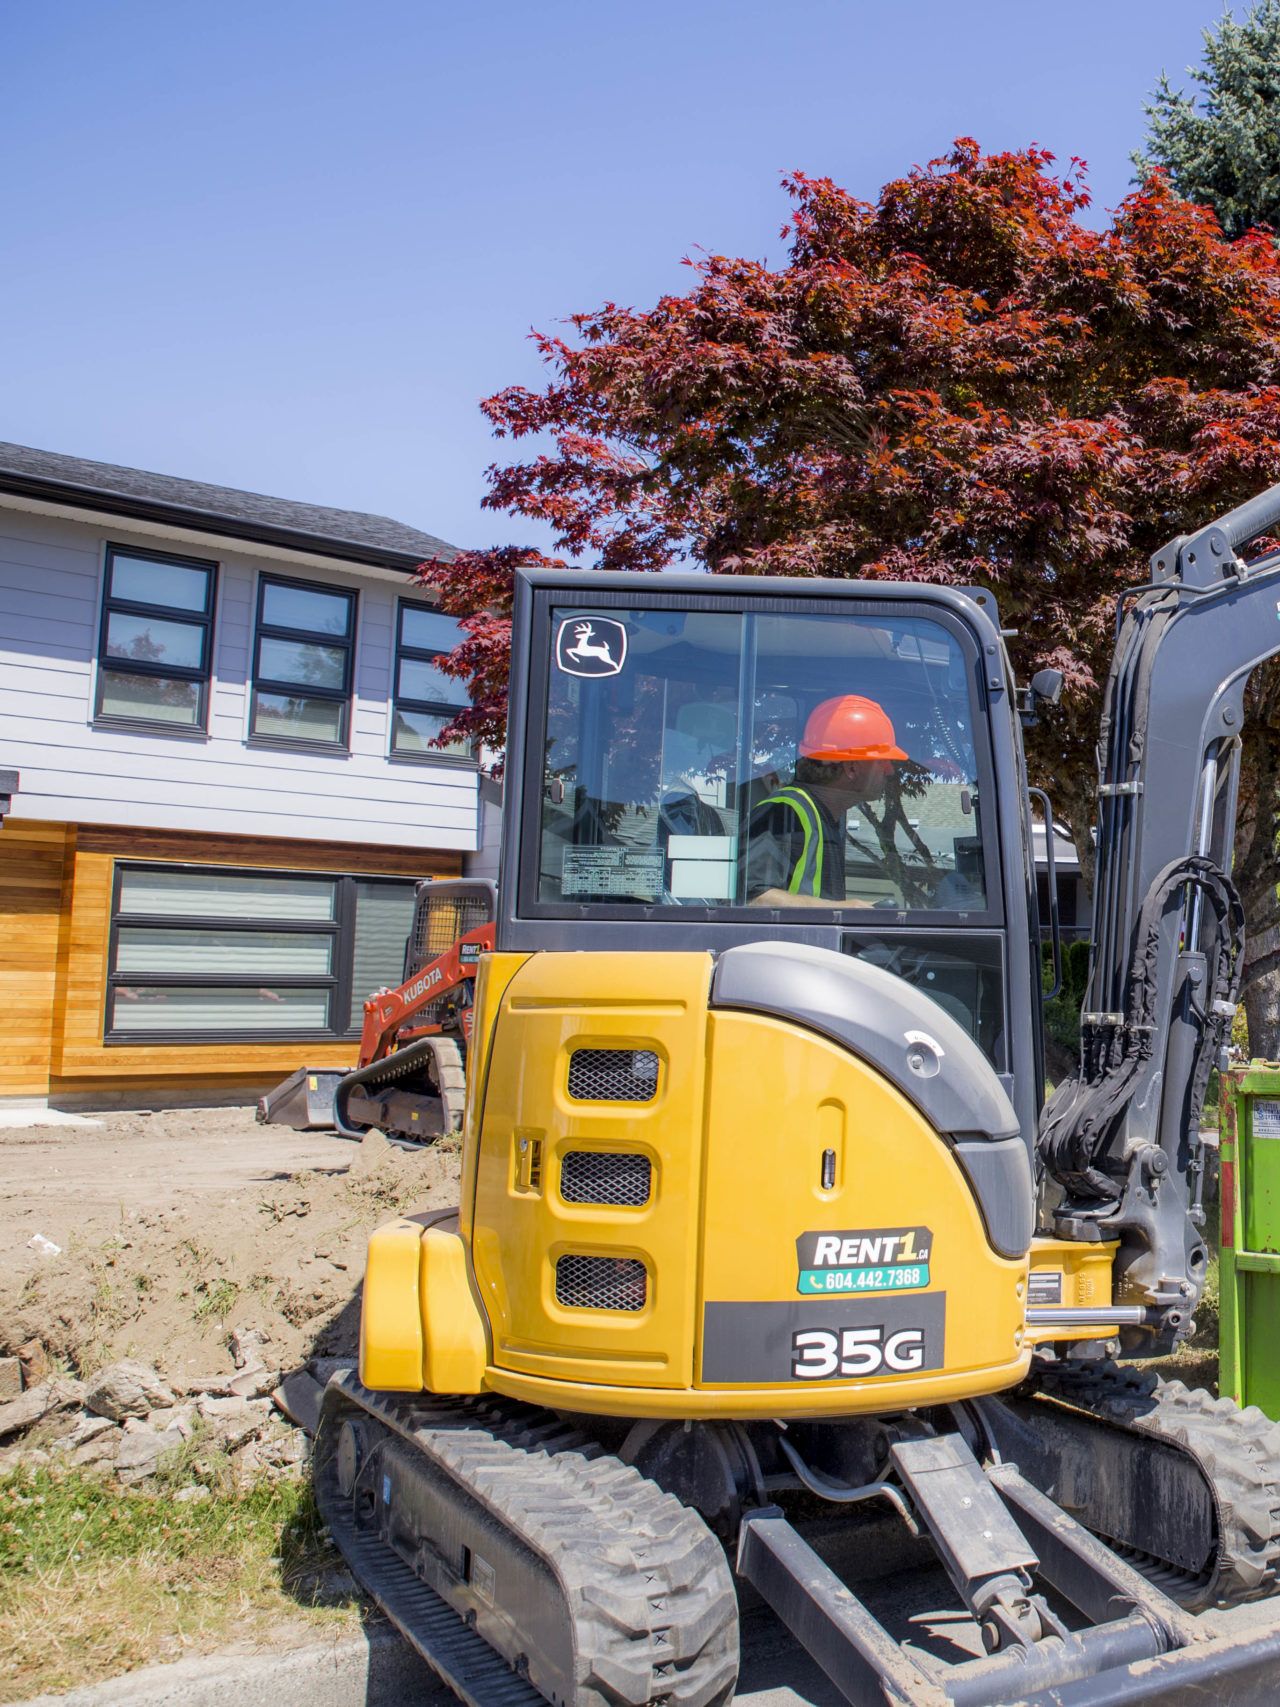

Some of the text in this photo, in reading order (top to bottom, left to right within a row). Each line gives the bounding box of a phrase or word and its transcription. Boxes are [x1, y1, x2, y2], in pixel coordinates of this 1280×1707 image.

[402, 967, 443, 1005] KUBOTA
[825, 1267, 921, 1290] 604.442.7368
[793, 1325, 924, 1379] 35G
